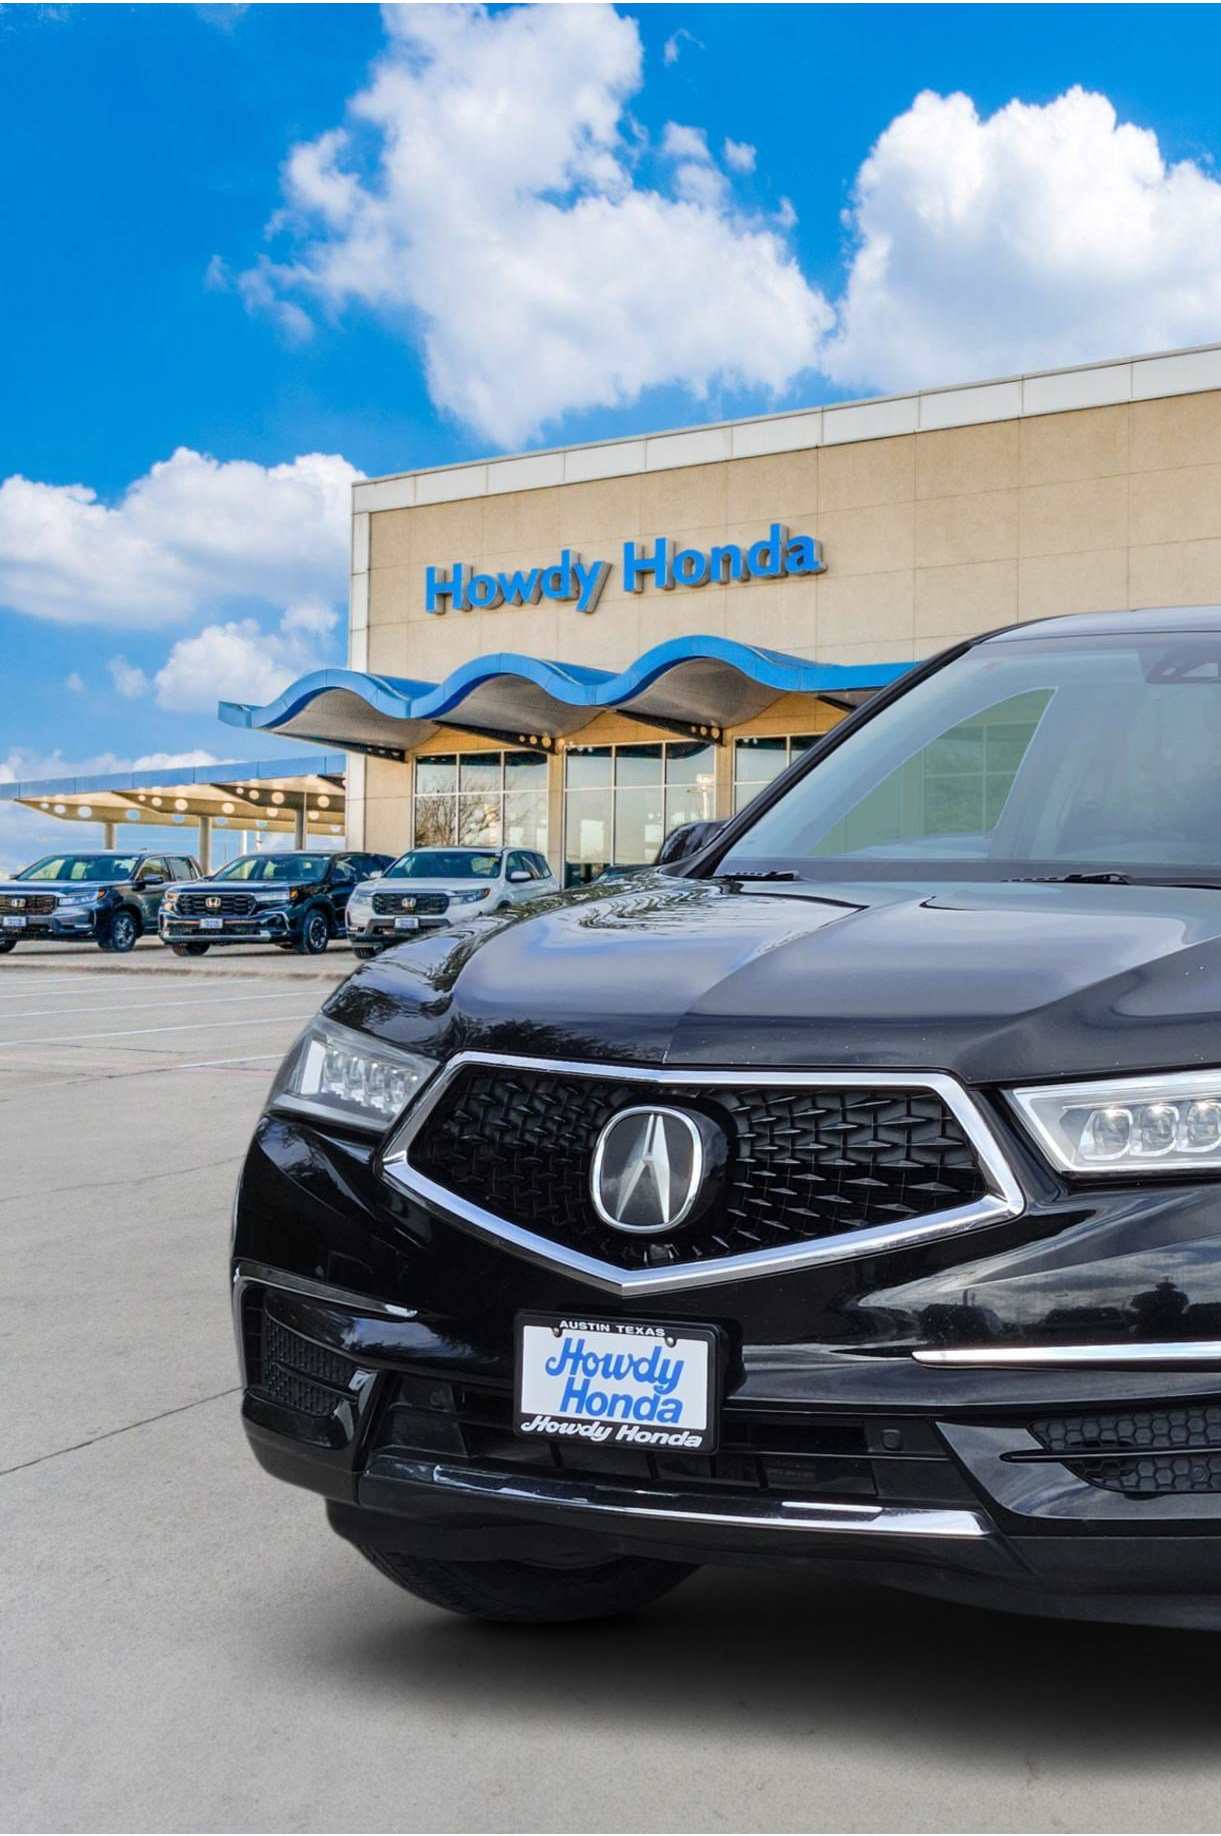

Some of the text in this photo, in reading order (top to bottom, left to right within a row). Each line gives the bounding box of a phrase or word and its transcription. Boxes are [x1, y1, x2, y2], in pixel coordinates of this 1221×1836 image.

[425, 523, 824, 614] Howdy Honda
[559, 1320, 666, 1338] AUSTIN TEXAS
[545, 1336, 685, 1395] Howdy
[559, 1377, 684, 1424] Honda
[520, 1415, 703, 1448] Howdy Honda
